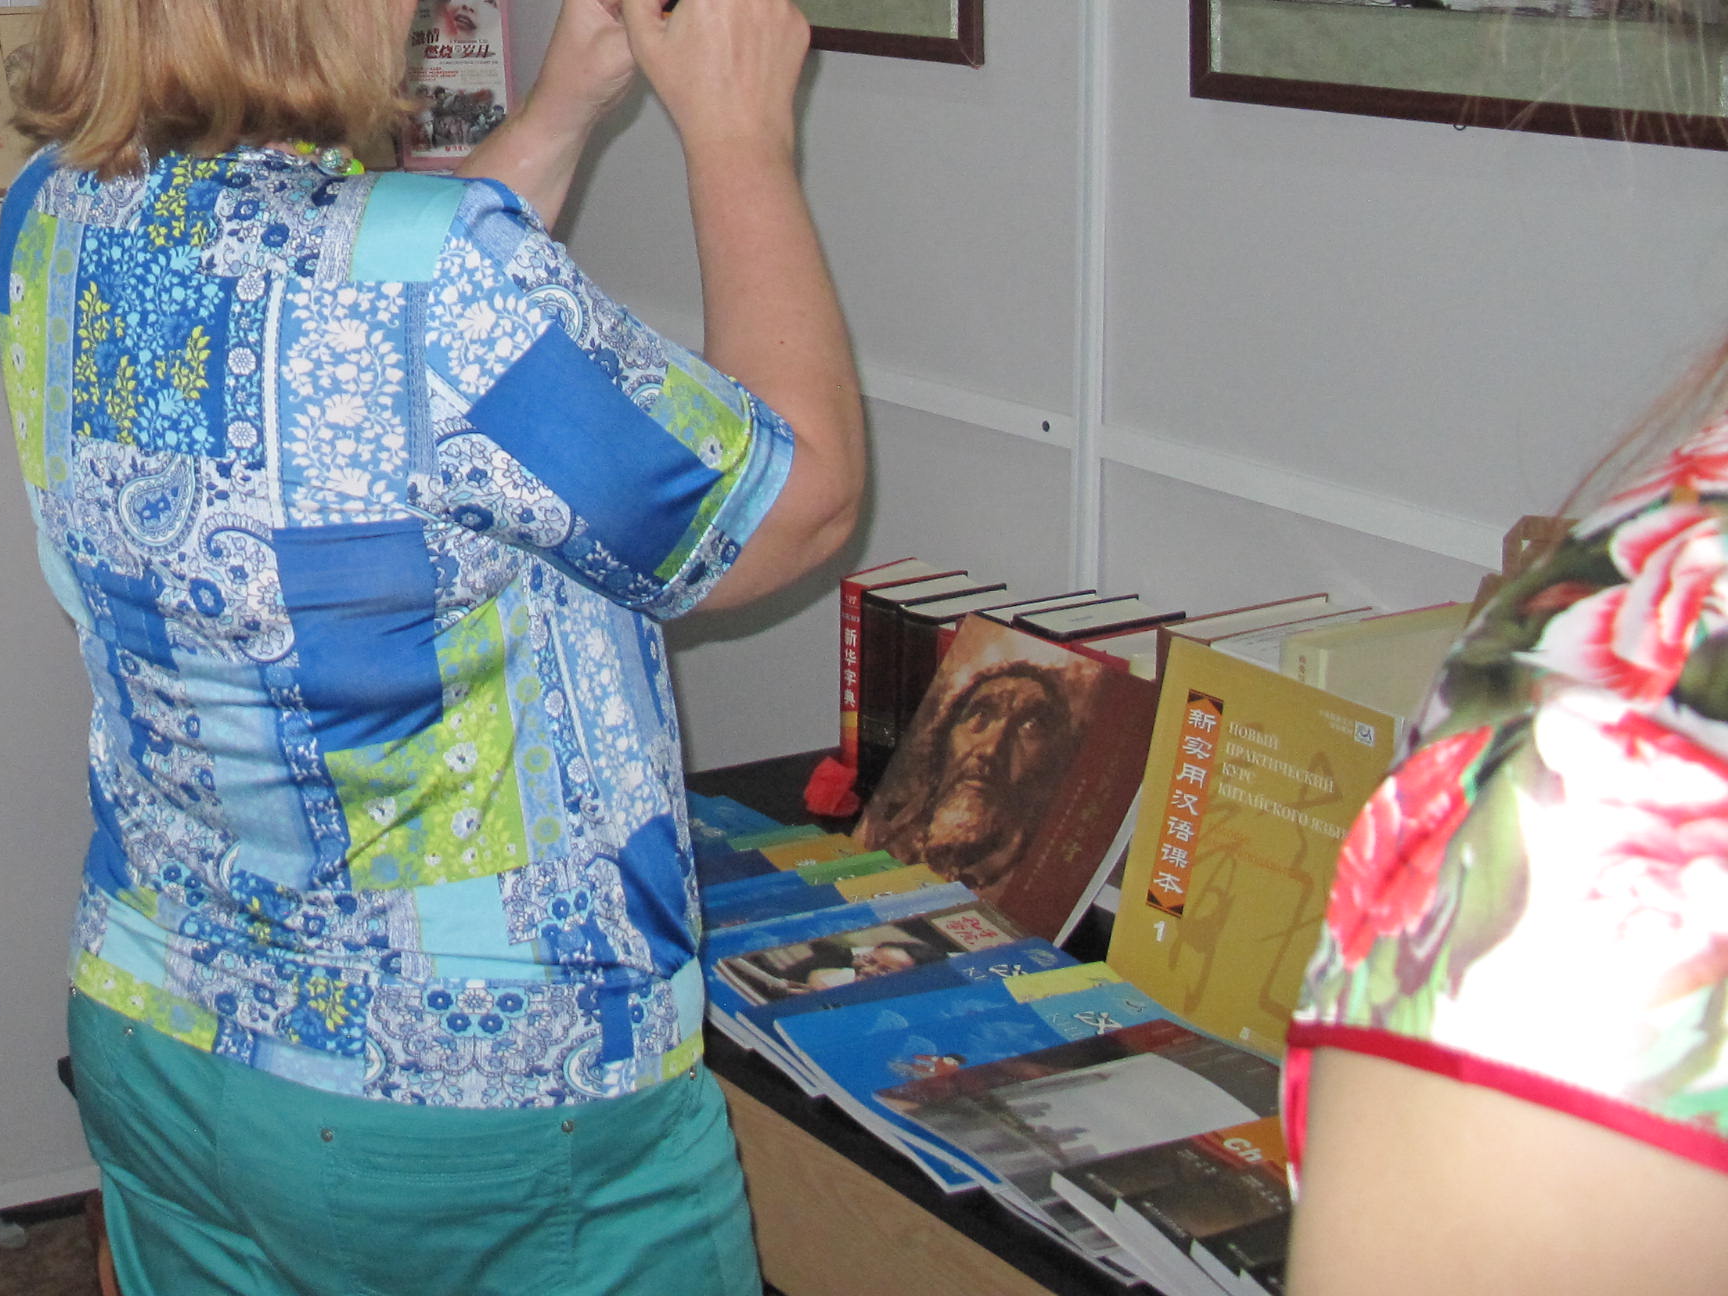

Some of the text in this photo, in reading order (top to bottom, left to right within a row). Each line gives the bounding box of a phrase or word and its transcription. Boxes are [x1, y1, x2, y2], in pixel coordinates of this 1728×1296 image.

[844, 627, 858, 708] 新华字典
[1228, 721, 1281, 751] НОВЫЙ
[1222, 762, 1258, 785] КУРС
[1152, 707, 1218, 896] 新实用汉语课本
[1152, 920, 1168, 942] 1
